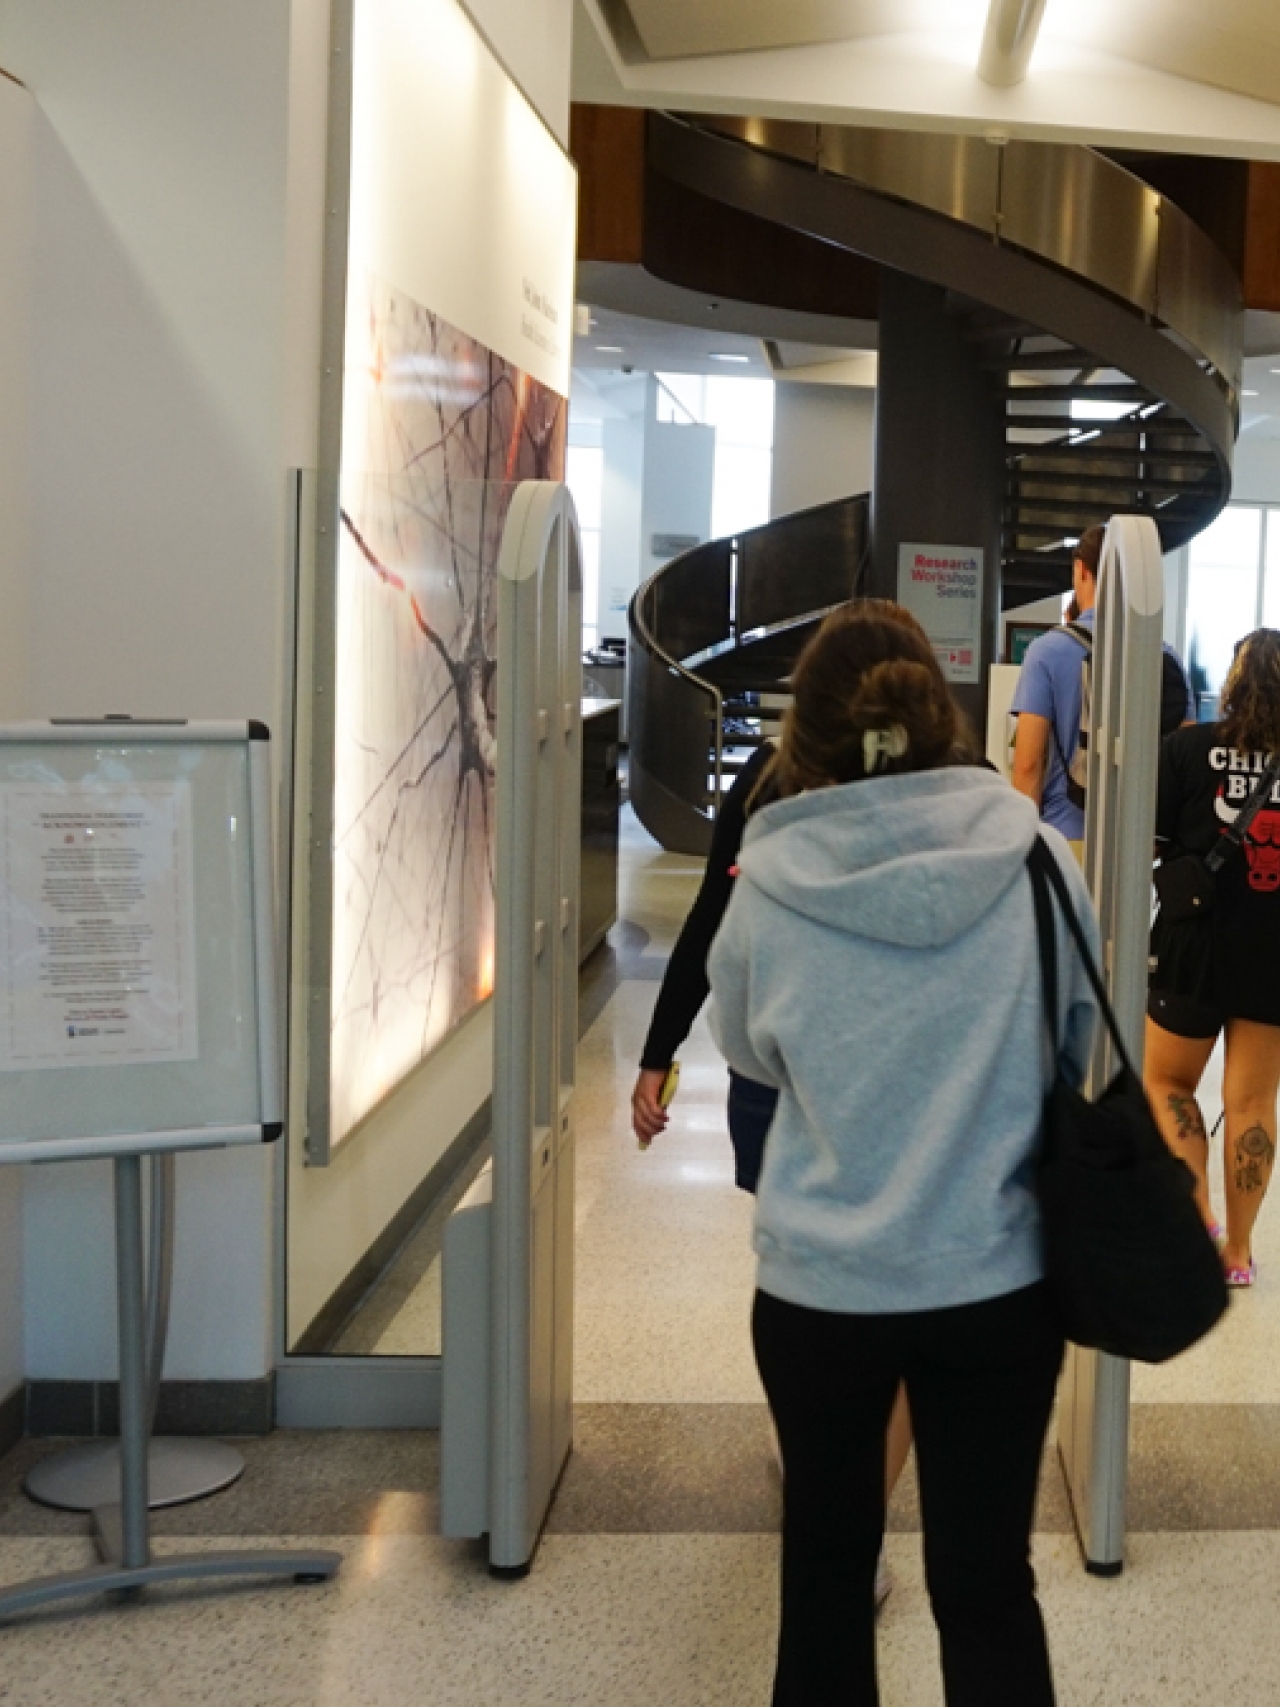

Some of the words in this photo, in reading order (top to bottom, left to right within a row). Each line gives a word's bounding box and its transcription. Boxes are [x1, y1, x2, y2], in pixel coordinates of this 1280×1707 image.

[914, 553, 978, 570] Research
[910, 569, 978, 586] Workshop
[937, 585, 977, 599] Series
